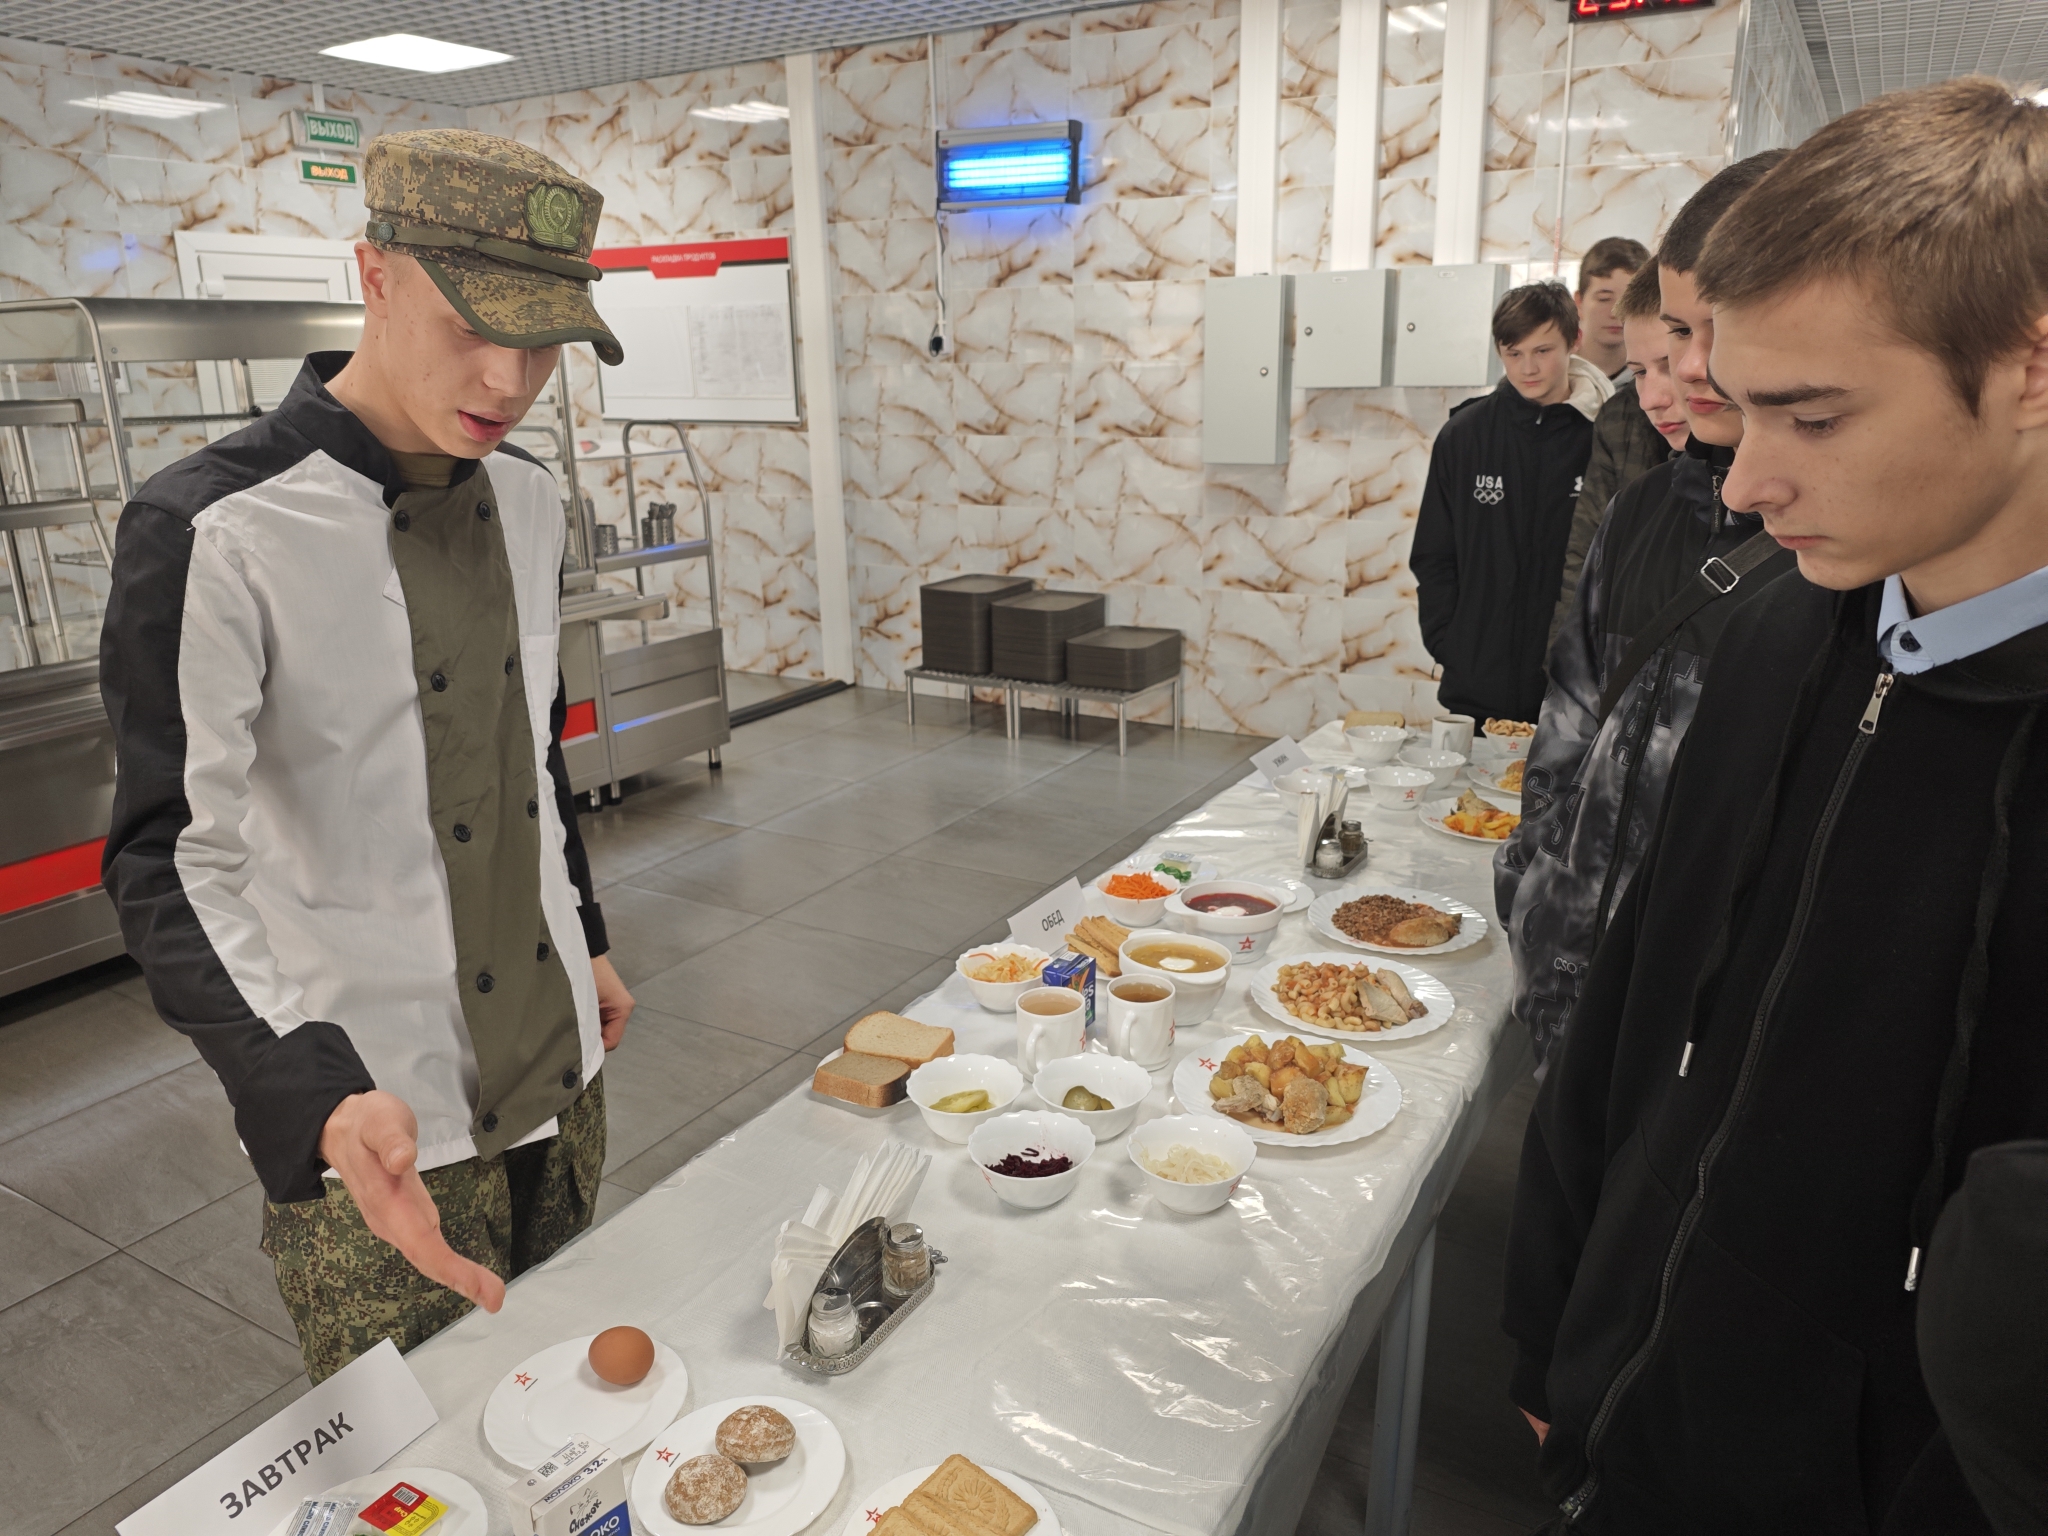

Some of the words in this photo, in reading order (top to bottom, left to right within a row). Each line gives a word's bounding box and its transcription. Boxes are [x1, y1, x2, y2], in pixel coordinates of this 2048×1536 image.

[310, 120, 354, 143] ВЫХОД
[311, 165, 348, 181] ВЫХОД
[1476, 475, 1503, 489] USA
[1041, 910, 1065, 931] ОБЕД
[219, 1411, 354, 1519] ЗАВТРАК
